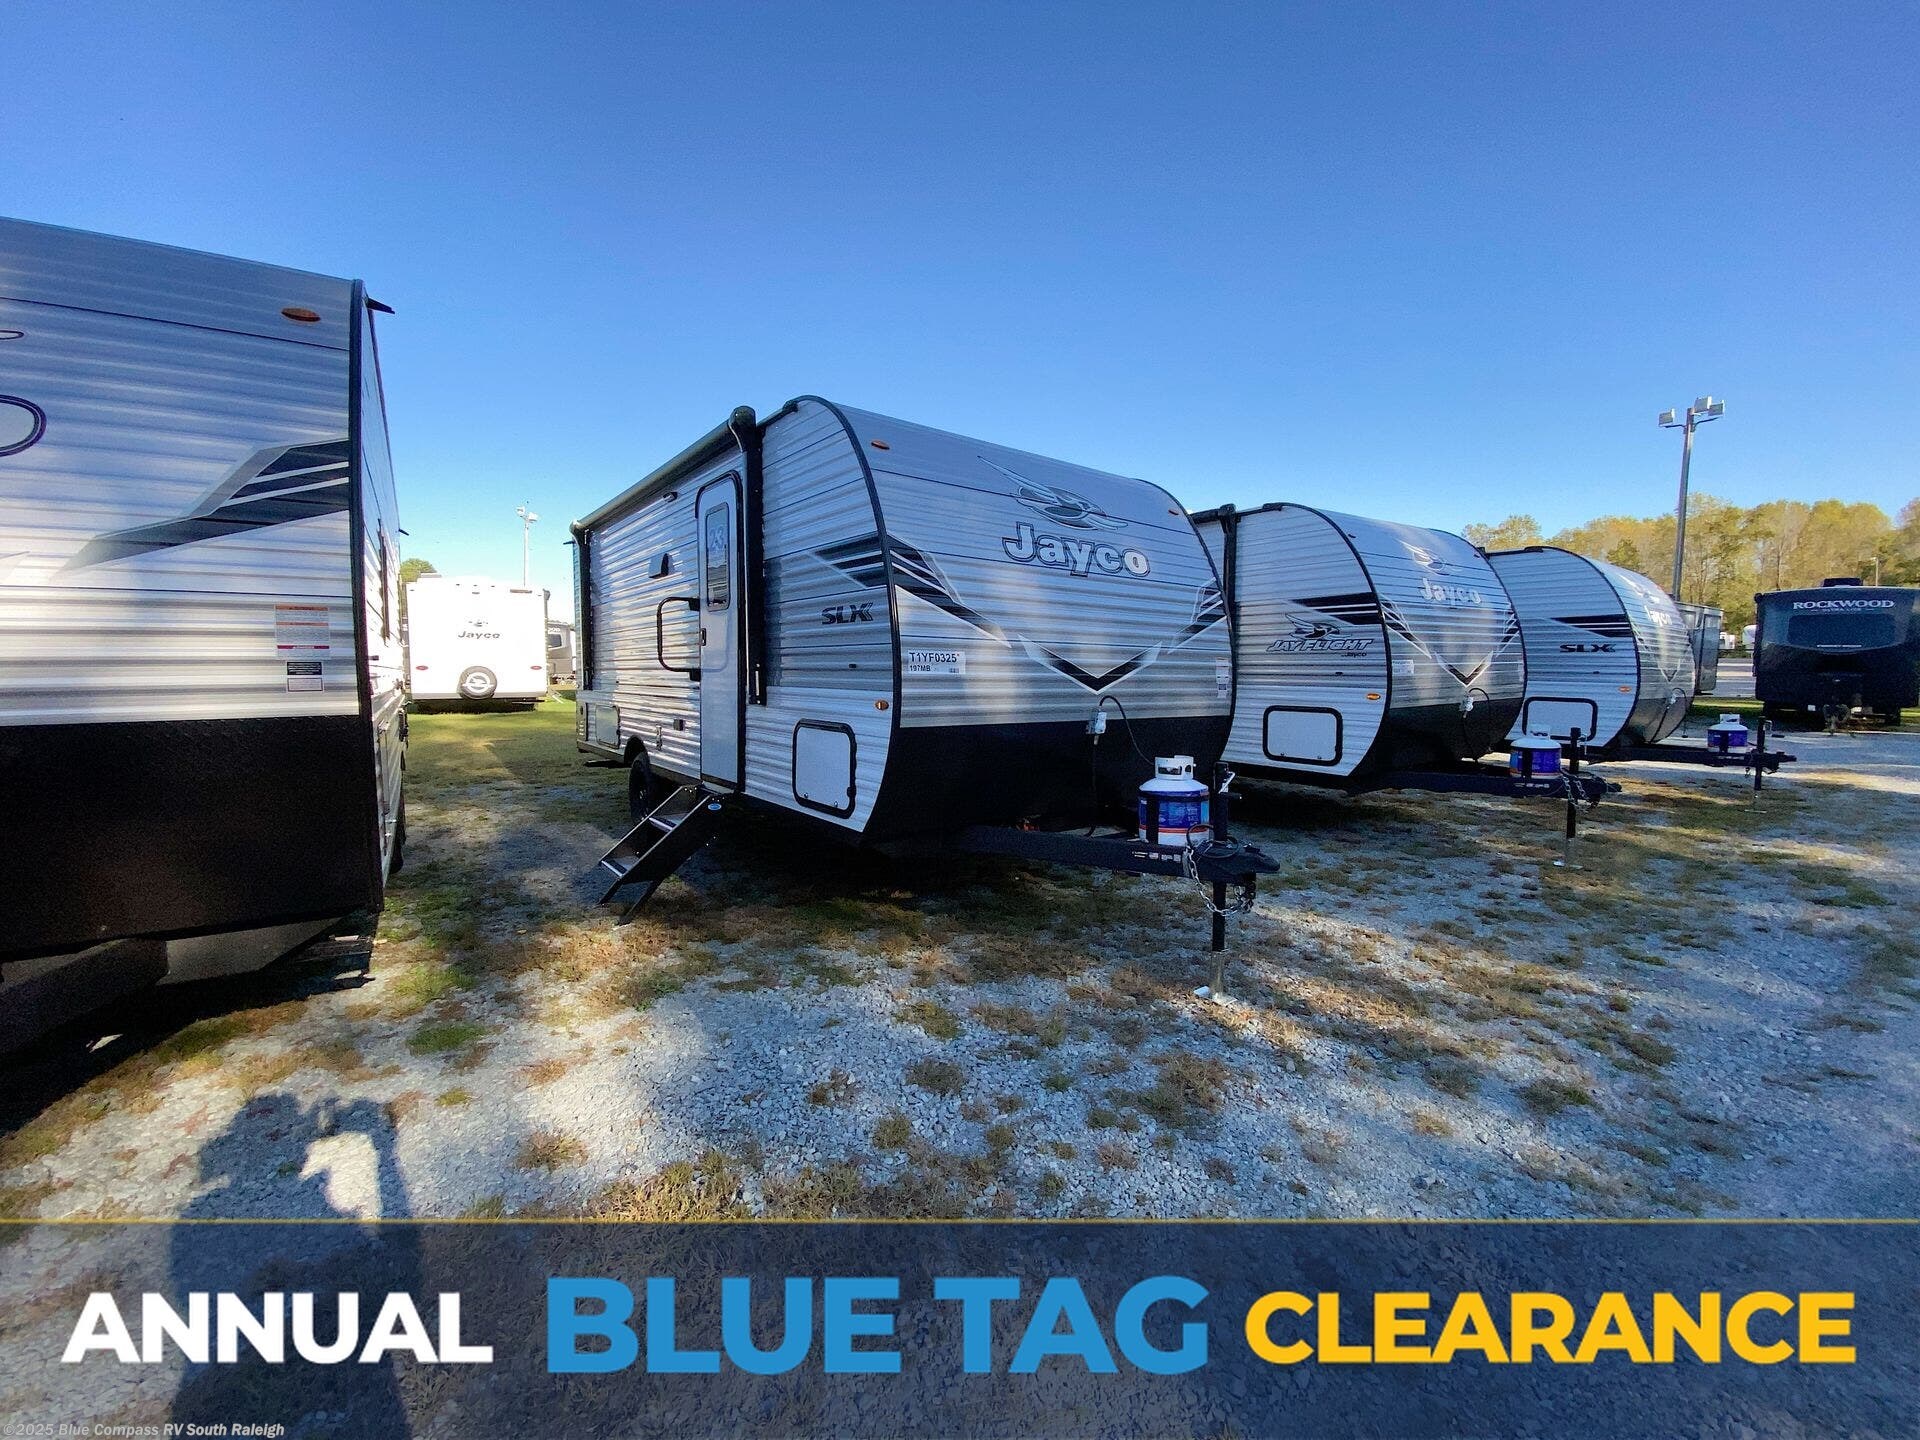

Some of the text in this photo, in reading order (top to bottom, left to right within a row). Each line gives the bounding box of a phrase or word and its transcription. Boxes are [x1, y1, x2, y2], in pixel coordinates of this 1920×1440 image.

[1002, 521, 1151, 577] Jayco
[1417, 577, 1481, 604] Jayco
[1793, 600, 1895, 610] ROCKWOOD
[821, 602, 874, 625] SLX
[458, 631, 500, 639] Jayco
[1265, 638, 1375, 652] JAY FLIGHT
[1560, 643, 1616, 653] SLX
[909, 652, 957, 663] T1YF0325
